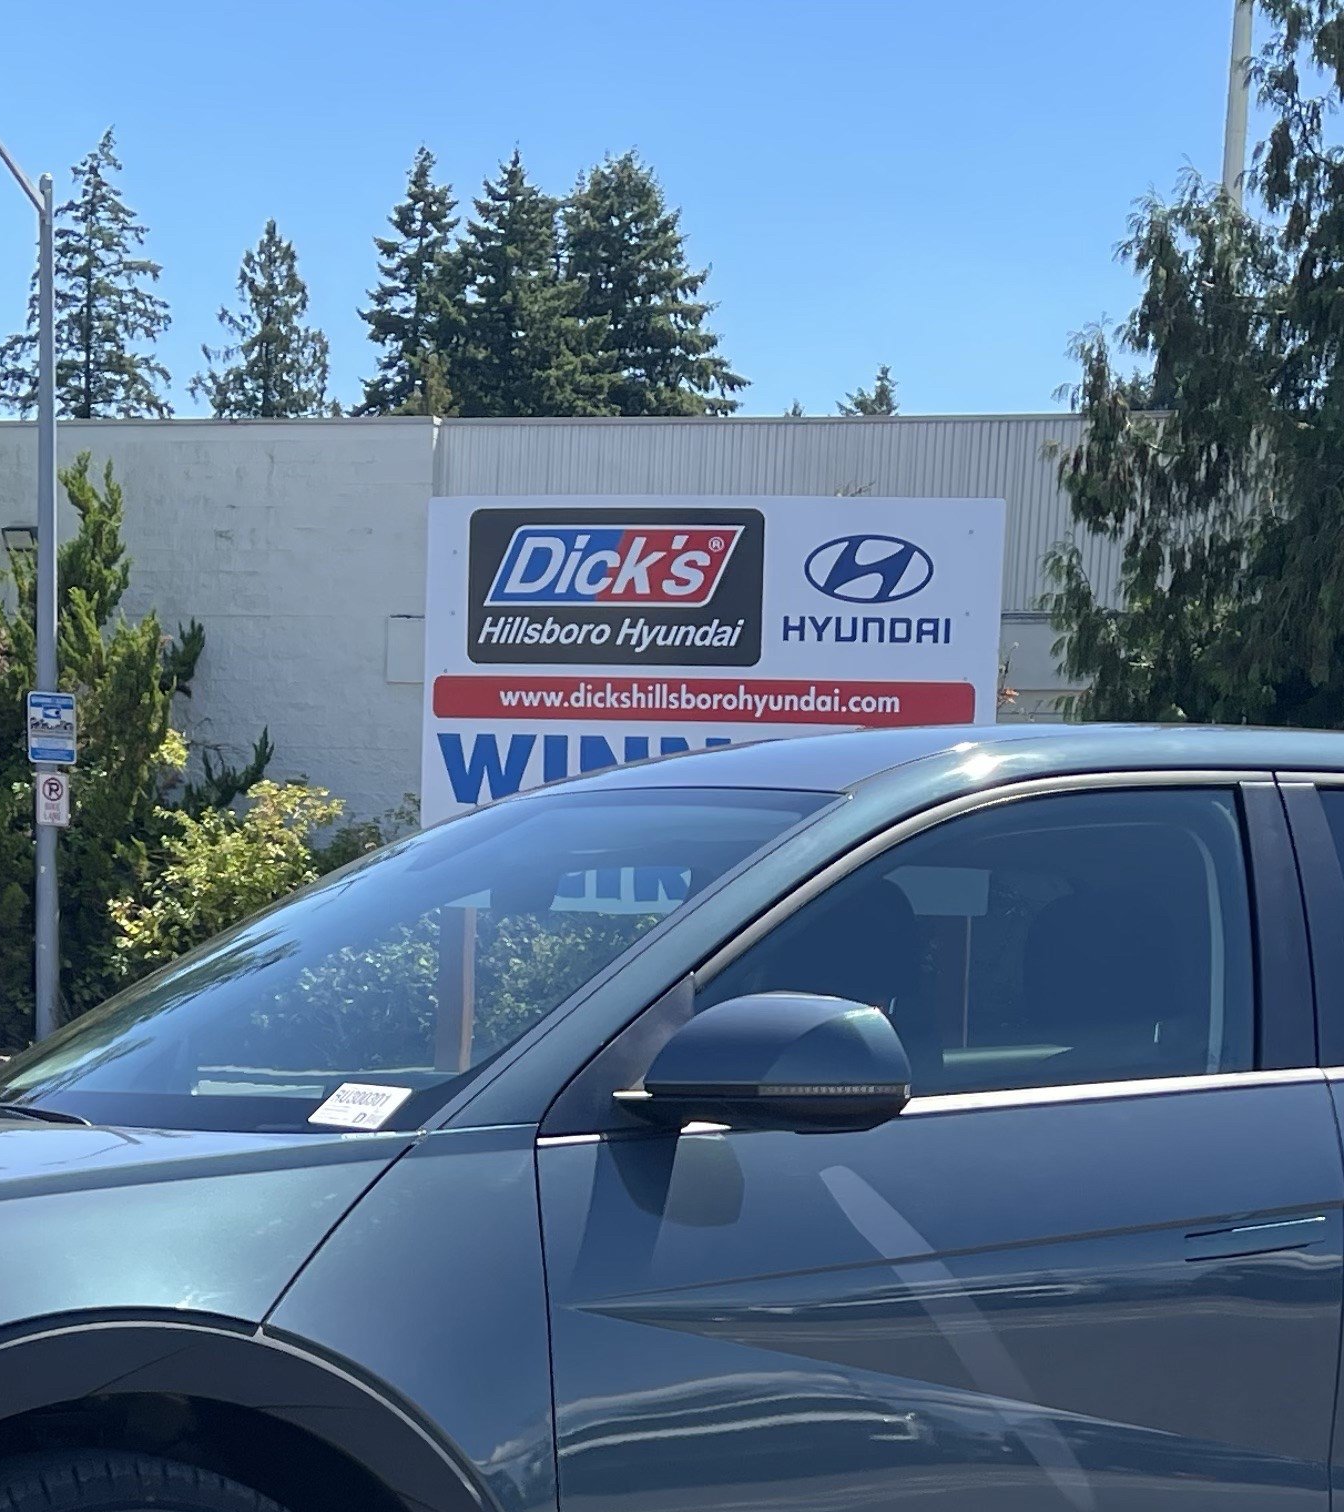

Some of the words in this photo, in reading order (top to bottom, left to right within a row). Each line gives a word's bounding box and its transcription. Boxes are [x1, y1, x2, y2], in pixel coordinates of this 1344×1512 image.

[477, 616, 609, 647] Hillsboro
[616, 618, 744, 653] Hyundai
[783, 615, 951, 645] HYUNDAI
[499, 685, 900, 718] www.dickshillsborohyundai.com
